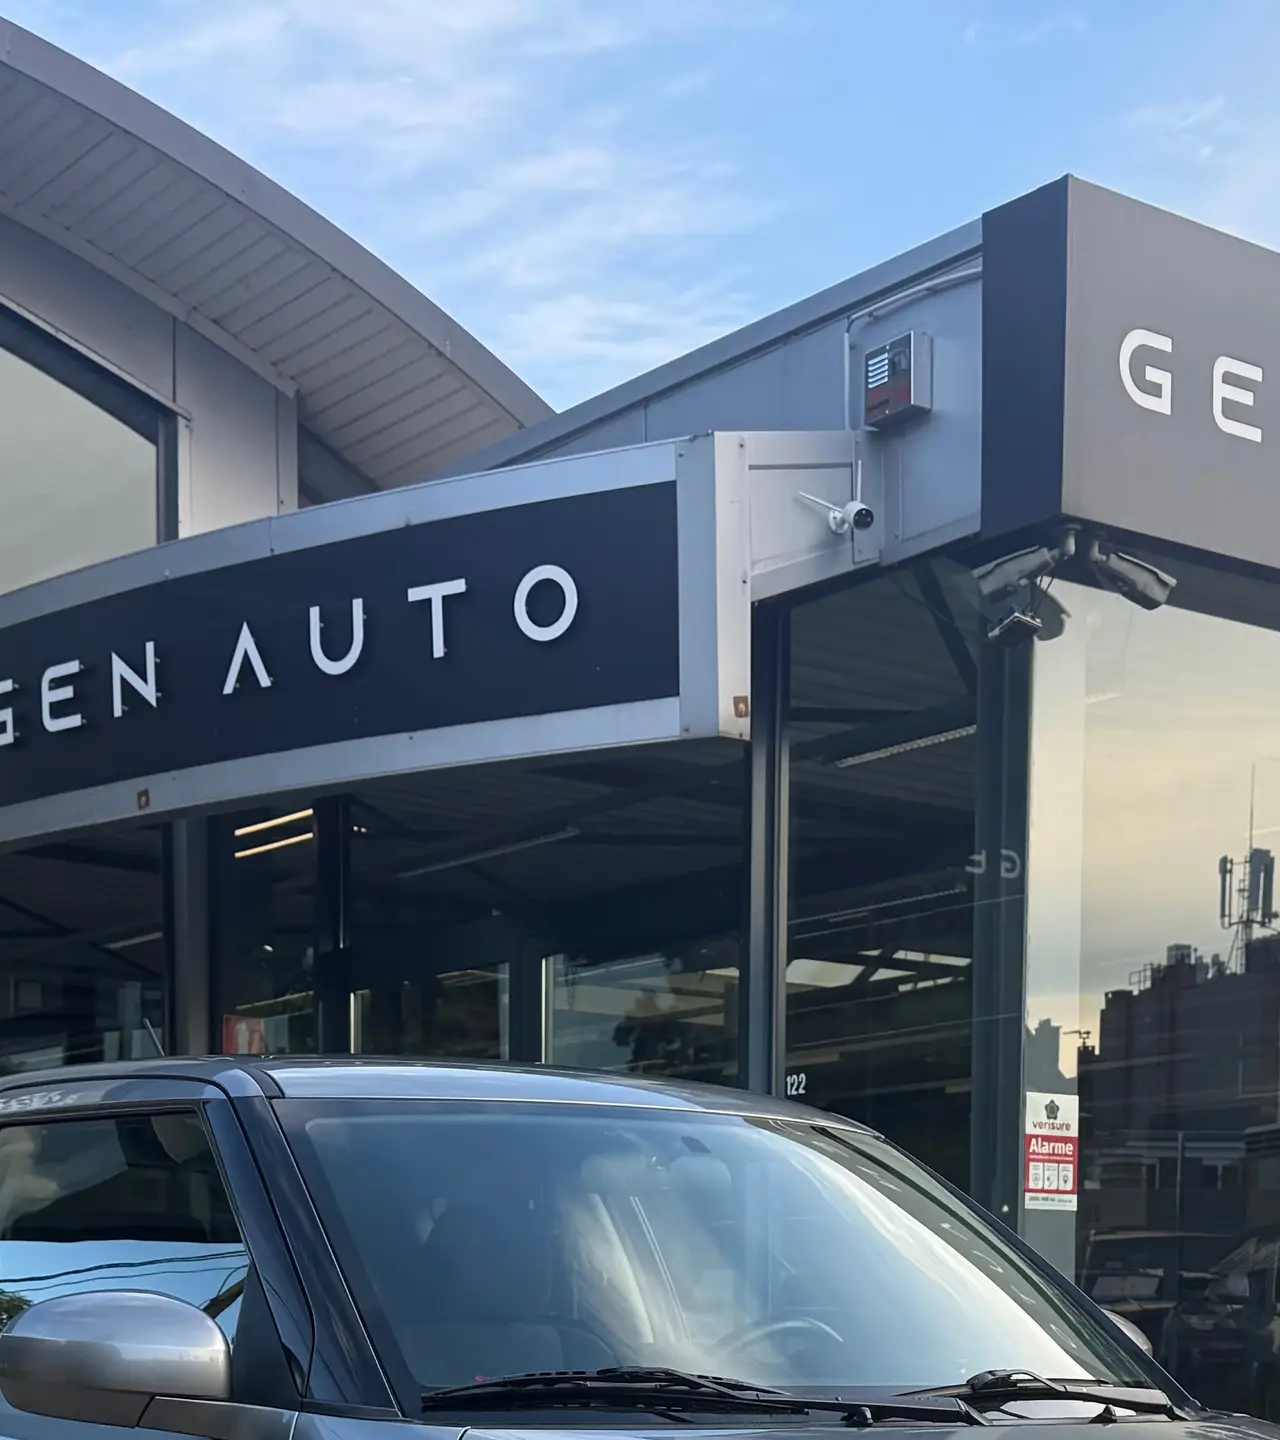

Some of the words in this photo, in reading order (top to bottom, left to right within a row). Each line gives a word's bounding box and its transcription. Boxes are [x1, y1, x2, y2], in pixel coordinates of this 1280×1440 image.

[222, 563, 579, 697] AUTO
[786, 1072, 807, 1096] 122
[1029, 1137, 1074, 1155] Alarme
